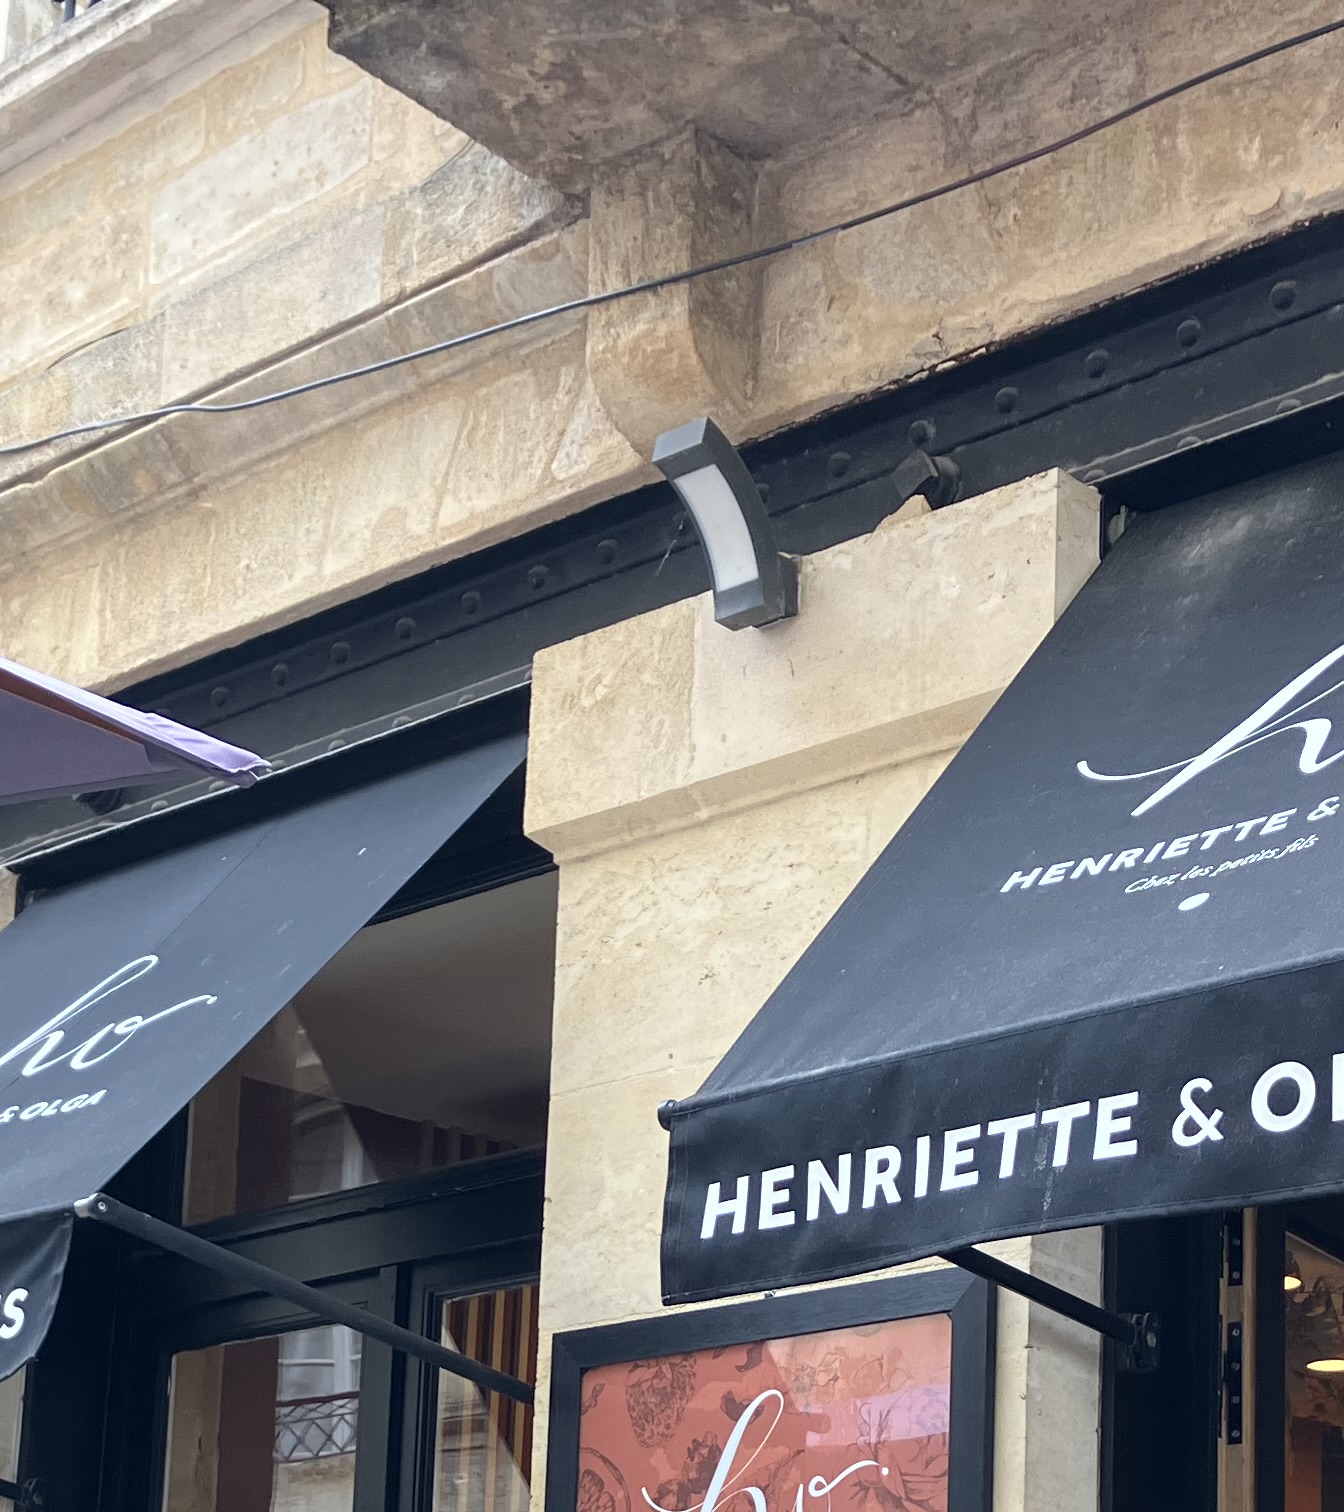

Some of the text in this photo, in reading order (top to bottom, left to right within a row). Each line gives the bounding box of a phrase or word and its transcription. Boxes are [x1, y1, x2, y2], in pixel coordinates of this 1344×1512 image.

[1000, 807, 1298, 893] HENRIETTE
[1306, 796, 1340, 822] &
[1124, 833, 1320, 893] Chez les petits fils
[19, 1089, 107, 1121] OLGA
[700, 1090, 1140, 1240] HENRIETTE
[1171, 1077, 1225, 1148] &
